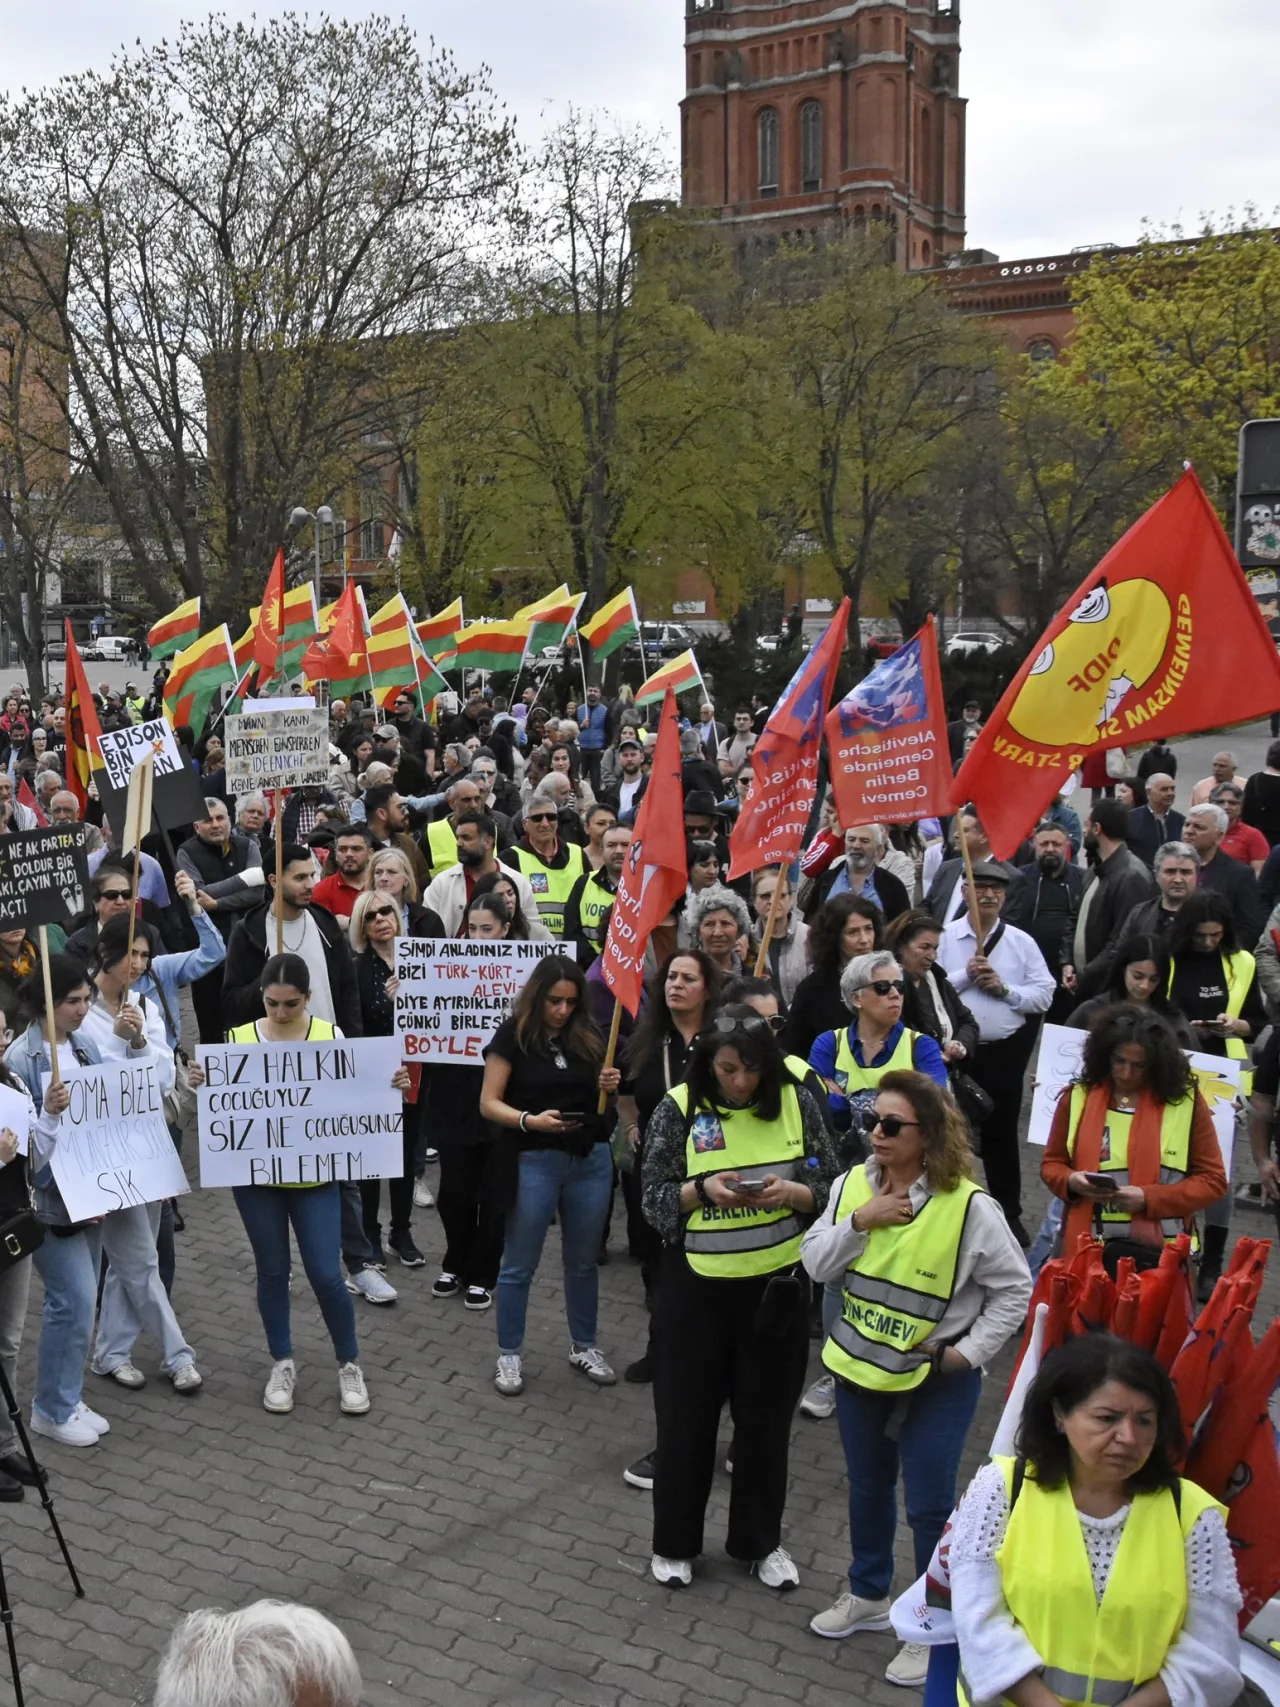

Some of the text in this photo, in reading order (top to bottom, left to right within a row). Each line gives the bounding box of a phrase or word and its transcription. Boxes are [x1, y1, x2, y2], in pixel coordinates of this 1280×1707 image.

[283, 715, 310, 728] KANN
[229, 737, 269, 758] MENSCHEN
[8, 842, 23, 860] NE
[25, 841, 39, 857] AK
[41, 833, 75, 852] PARTEA
[13, 852, 74, 878] DOLDUR BİR
[17, 876, 51, 896] ÇAYIN
[398, 939, 435, 960] ŞİMDİ
[439, 943, 513, 958] ANLADINIZ
[398, 964, 427, 981] BİZİ
[396, 994, 428, 1010] DİYE
[397, 1011, 441, 1032] ÇÜNKÜ
[404, 1032, 483, 1058] BÖYLE
[204, 1048, 357, 1088] BİZ HALKIN
[209, 1086, 314, 1115] ÇOCUĞUYUZ
[207, 1112, 405, 1153] SİZ NE ÇOCUĞUSUNUZ
[97, 1169, 148, 1214] SIK
